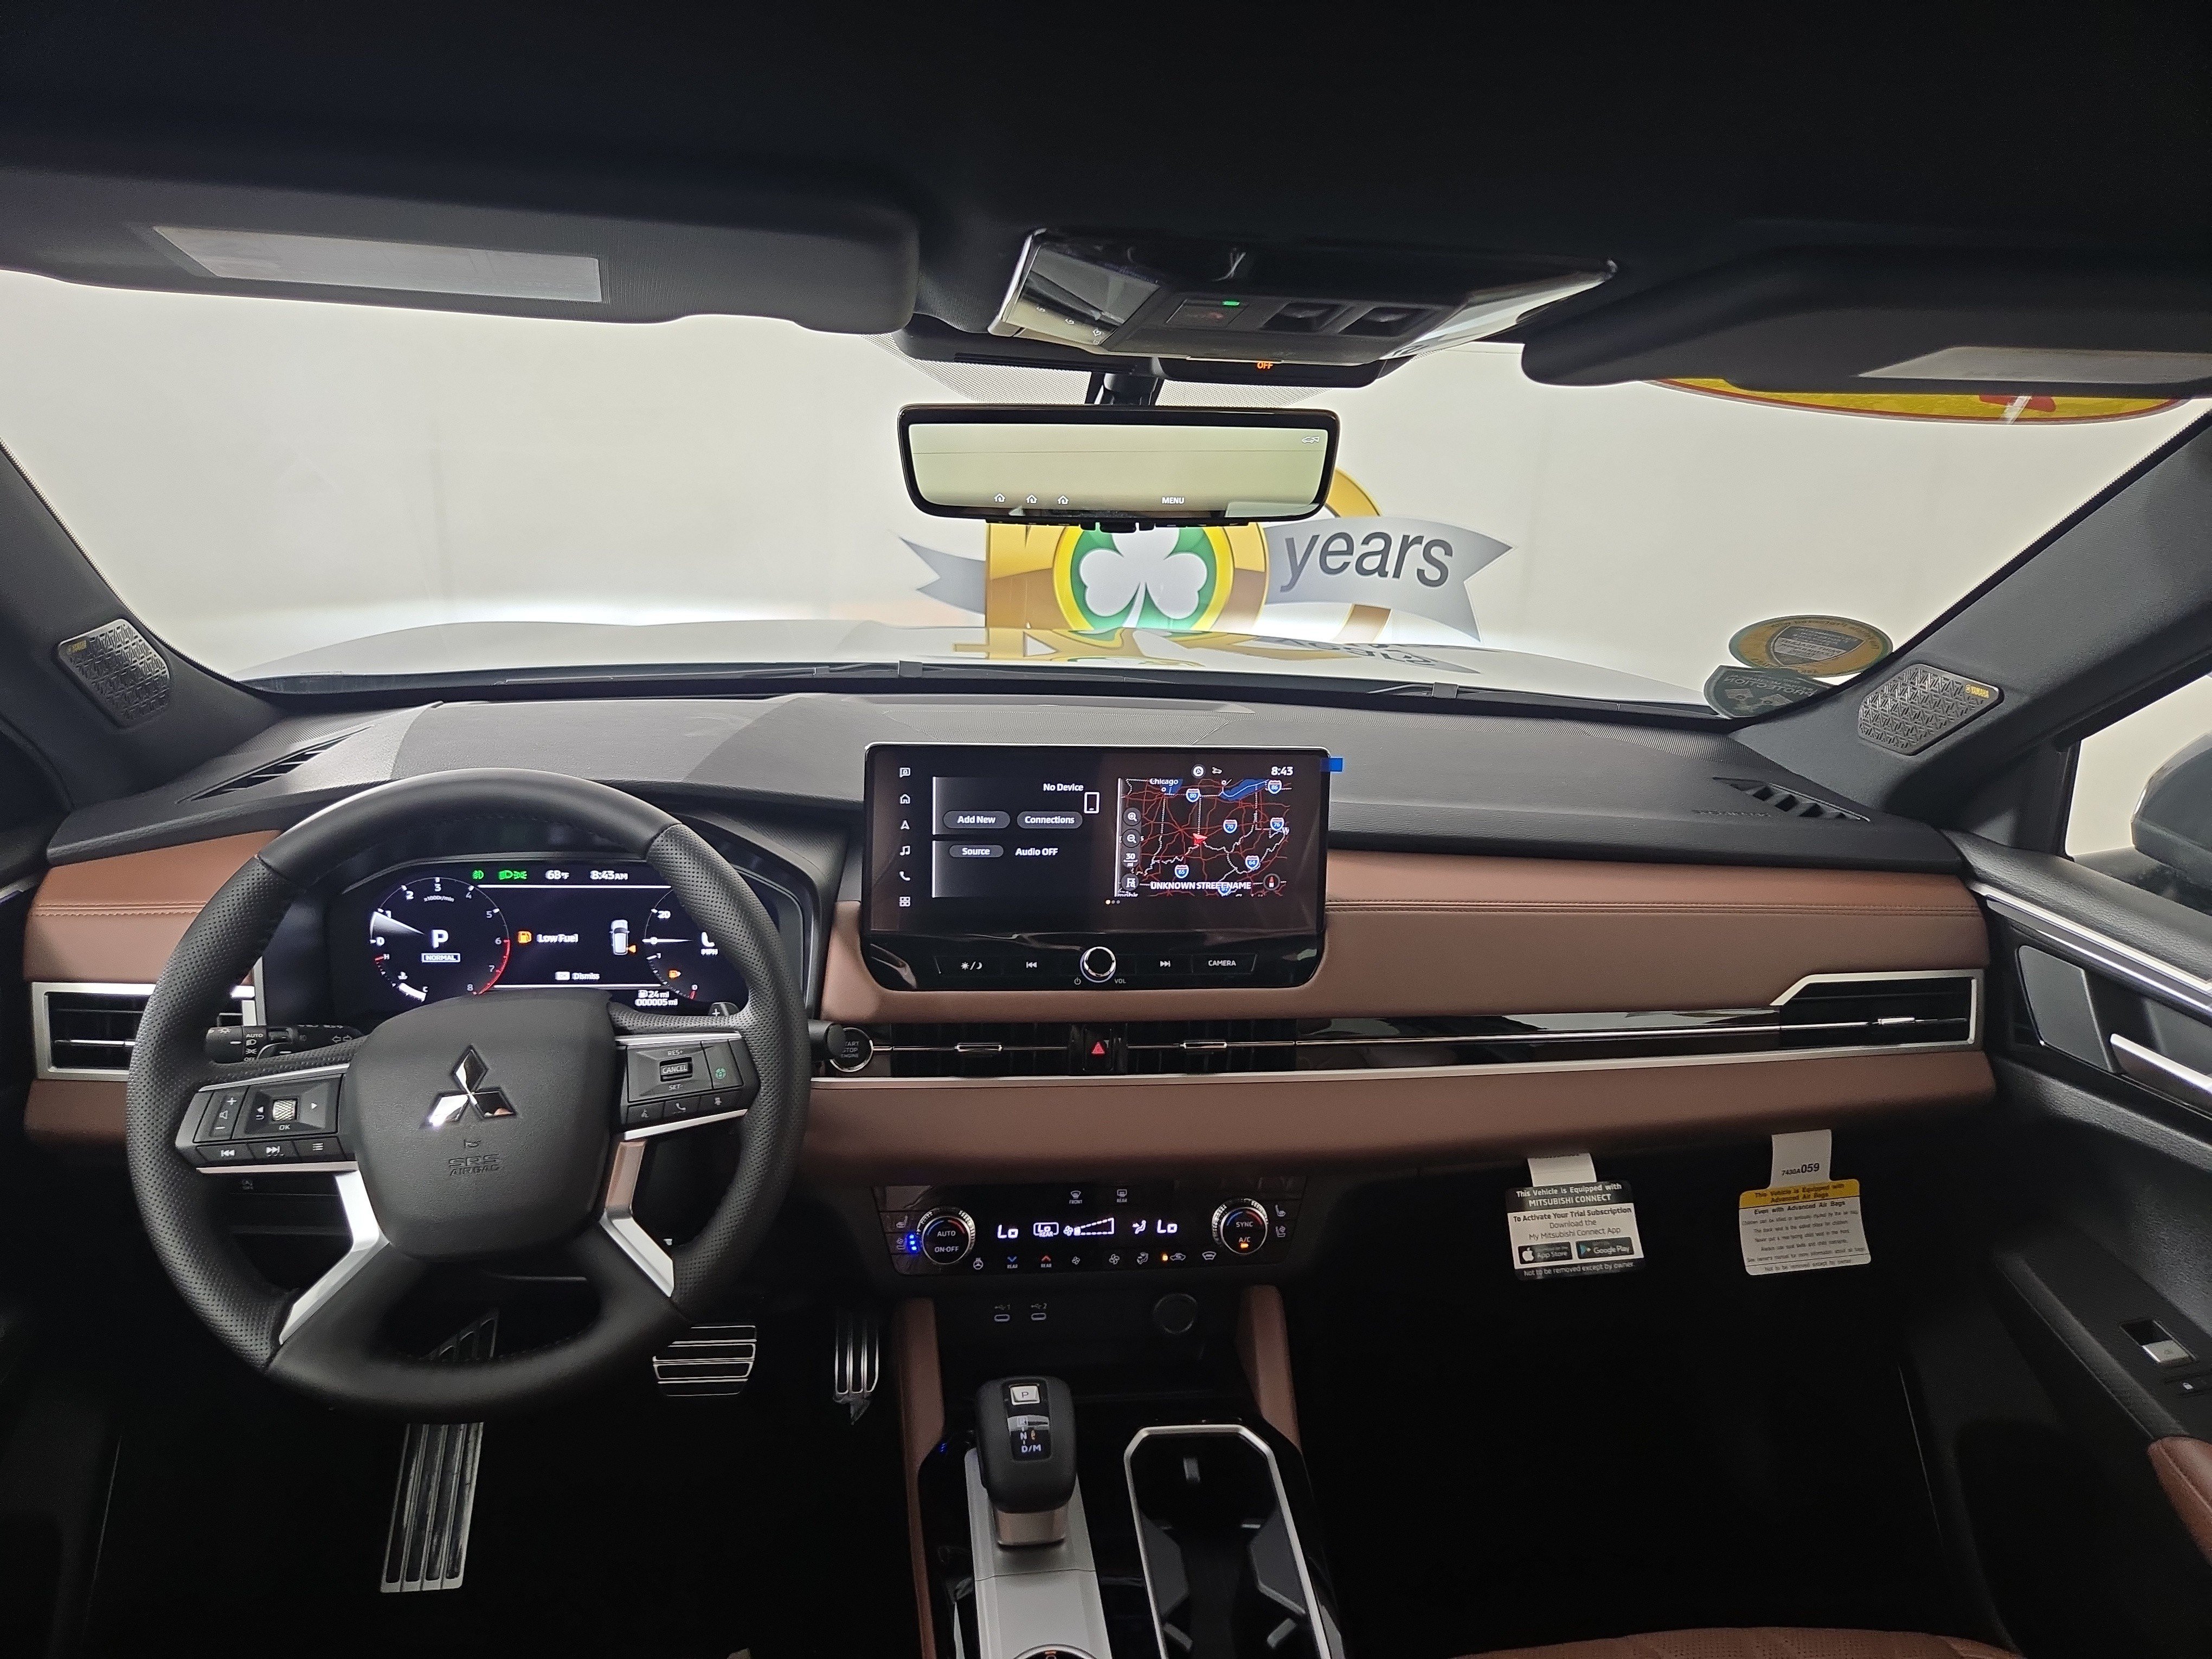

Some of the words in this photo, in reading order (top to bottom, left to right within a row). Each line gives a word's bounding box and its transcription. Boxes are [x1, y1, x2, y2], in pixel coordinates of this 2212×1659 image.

[1257, 361, 1273, 369] OFF
[1161, 496, 1185, 505] MENU
[1281, 526, 1455, 594] years
[1271, 766, 1294, 776] 8:43
[1043, 783, 1056, 792] No
[1057, 783, 1084, 792] Device
[957, 815, 975, 824] Add
[976, 815, 996, 824] New
[1024, 815, 1075, 824] Connections
[961, 847, 991, 856] Source
[1015, 847, 1041, 856] Audio
[1041, 847, 1058, 856] OFF
[434, 883, 442, 892] 3
[1150, 882, 1196, 890] UNKNOWN
[1197, 882, 1226, 890] STREET
[1227, 882, 1252, 890] NAME
[406, 891, 414, 900] 2
[385, 910, 392, 918] 1
[486, 910, 493, 918] 5
[657, 910, 671, 919] 20
[376, 936, 385, 947] 0
[432, 929, 449, 949] P
[494, 937, 502, 945] 6
[536, 934, 558, 943] Low
[558, 934, 579, 943] Fuel
[488, 964, 496, 973] 7
[571, 972, 600, 980] Dismiss
[467, 983, 474, 992] 8
[662, 1064, 688, 1074] CANCEL
[448, 1153, 500, 1167] SRS
[449, 1163, 501, 1176] AIRBAG
[1516, 1188, 1531, 1198] This
[1532, 1187, 1558, 1197] Vehicle
[1560, 1186, 1567, 1194] is
[1570, 1184, 1603, 1194] Equipped
[1605, 1182, 1622, 1191] with
[1528, 1196, 1573, 1207] MITSUBISHI
[1574, 1193, 1612, 1203] CONNECT
[1754, 1207, 1769, 1215] Even
[1787, 1203, 1816, 1211] Advanced
[1830, 1199, 1846, 1207] Bags
[1522, 1212, 1551, 1221] Activate
[1552, 1211, 1568, 1220] Your
[1571, 1208, 1586, 1218] Trial
[1586, 1206, 1632, 1217] Subscription
[1037, 1224, 1051, 1232] Lo
[1156, 1219, 1178, 1233] Lo
[1549, 1220, 1584, 1230] Download
[1585, 1218, 1597, 1226] the
[997, 1224, 1019, 1239] Lo
[1540, 1230, 1576, 1240] Mitsubishi
[1577, 1227, 1605, 1237] Connect
[1606, 1226, 1621, 1236] App
[1536, 1251, 1550, 1259] App
[1551, 1249, 1568, 1257] Store
[1593, 1245, 1617, 1255] Google
[1617, 1244, 1630, 1254] Play
[1553, 1264, 1581, 1274] removed
[1581, 1263, 1604, 1272] except
[1604, 1262, 1613, 1271] by
[1019, 1431, 1028, 1441] N
[1021, 1443, 1042, 1454] D/M
